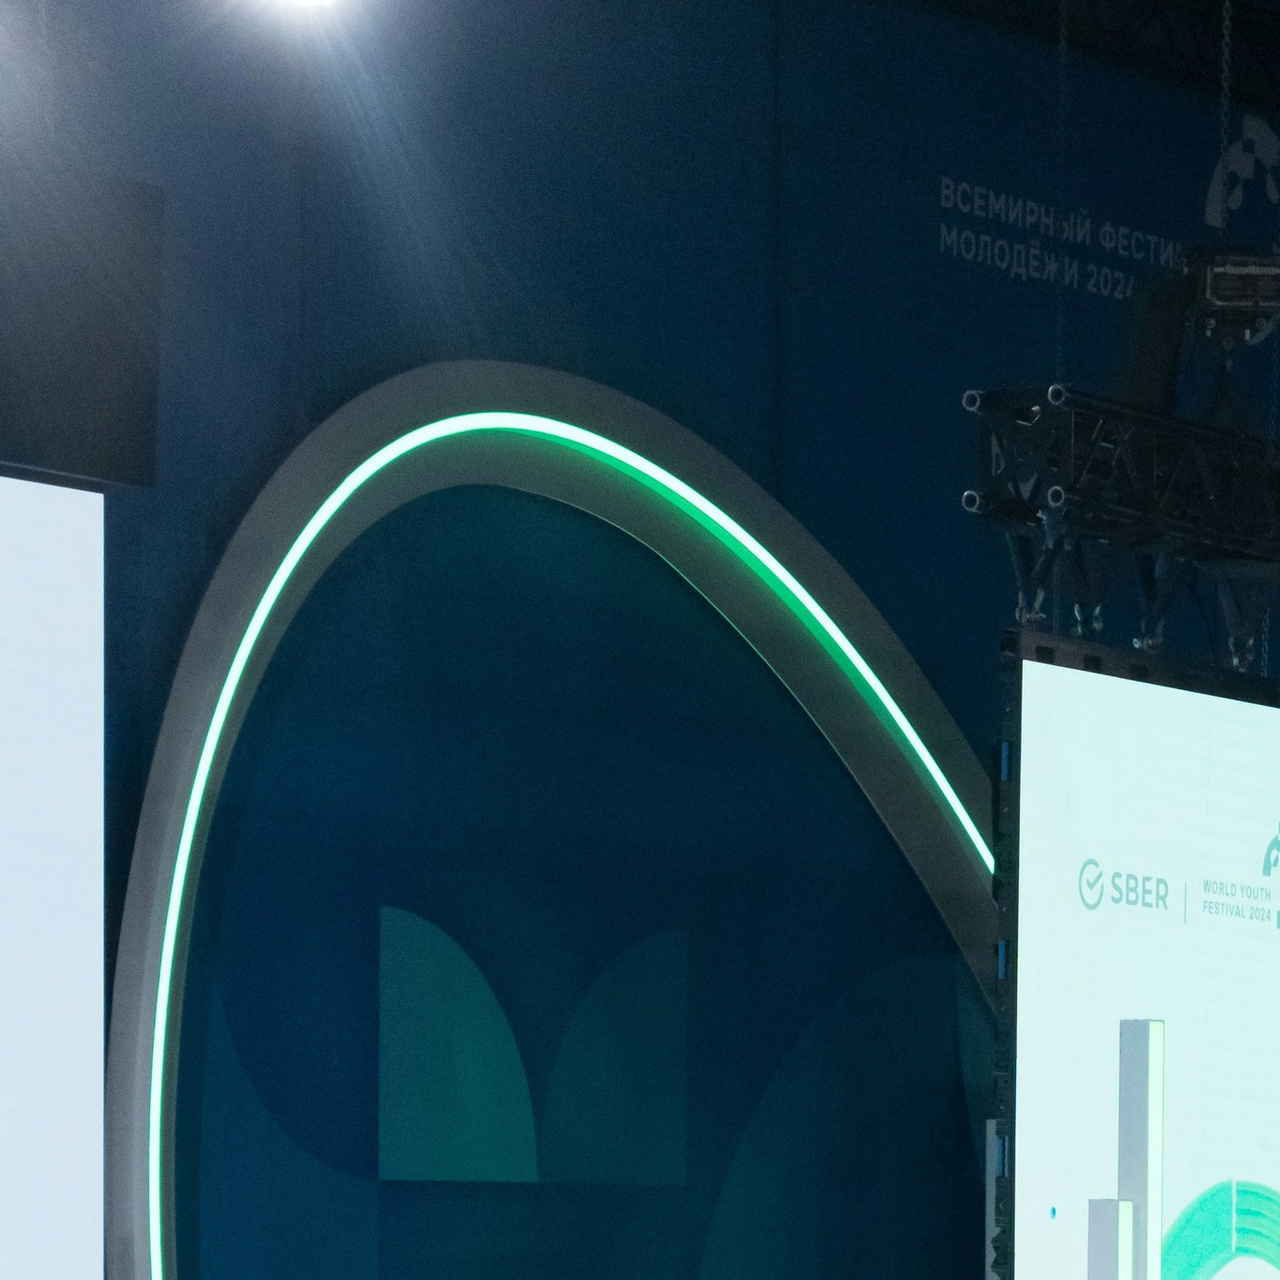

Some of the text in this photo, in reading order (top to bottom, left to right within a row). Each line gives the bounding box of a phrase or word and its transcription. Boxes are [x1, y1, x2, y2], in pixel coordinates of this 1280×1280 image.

[940, 225, 1078, 284] МОЛОДЁЖИ
[1111, 872, 1169, 910] SBER
[1203, 880, 1271, 901] WORLD YOUTH
[1203, 900, 1271, 922] FESTIVAL 2024
